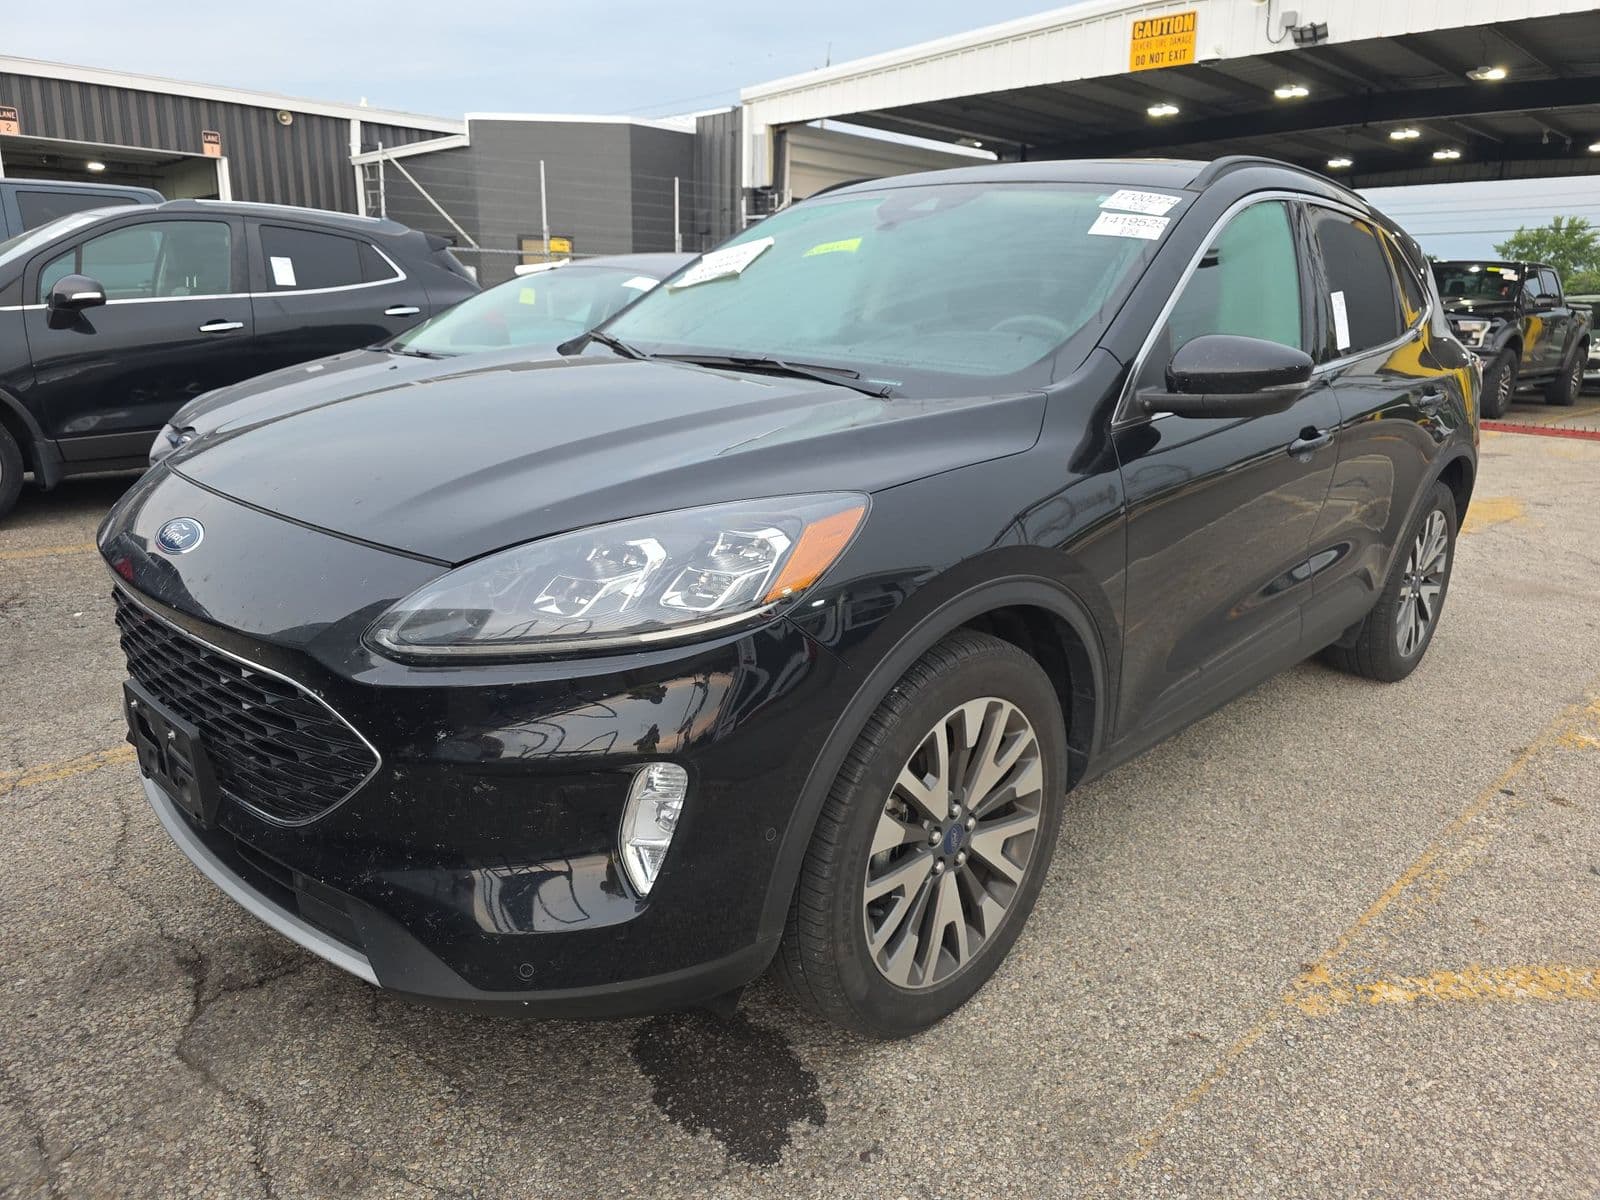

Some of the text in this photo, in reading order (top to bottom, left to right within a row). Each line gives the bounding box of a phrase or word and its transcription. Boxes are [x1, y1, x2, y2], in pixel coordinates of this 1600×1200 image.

[1133, 13, 1195, 39] CAUTION
[1136, 49, 1187, 66] DO NOT EXIT
[6, 122, 12, 131] 2
[204, 134, 219, 142] LANE
[162, 523, 191, 546] Ford
